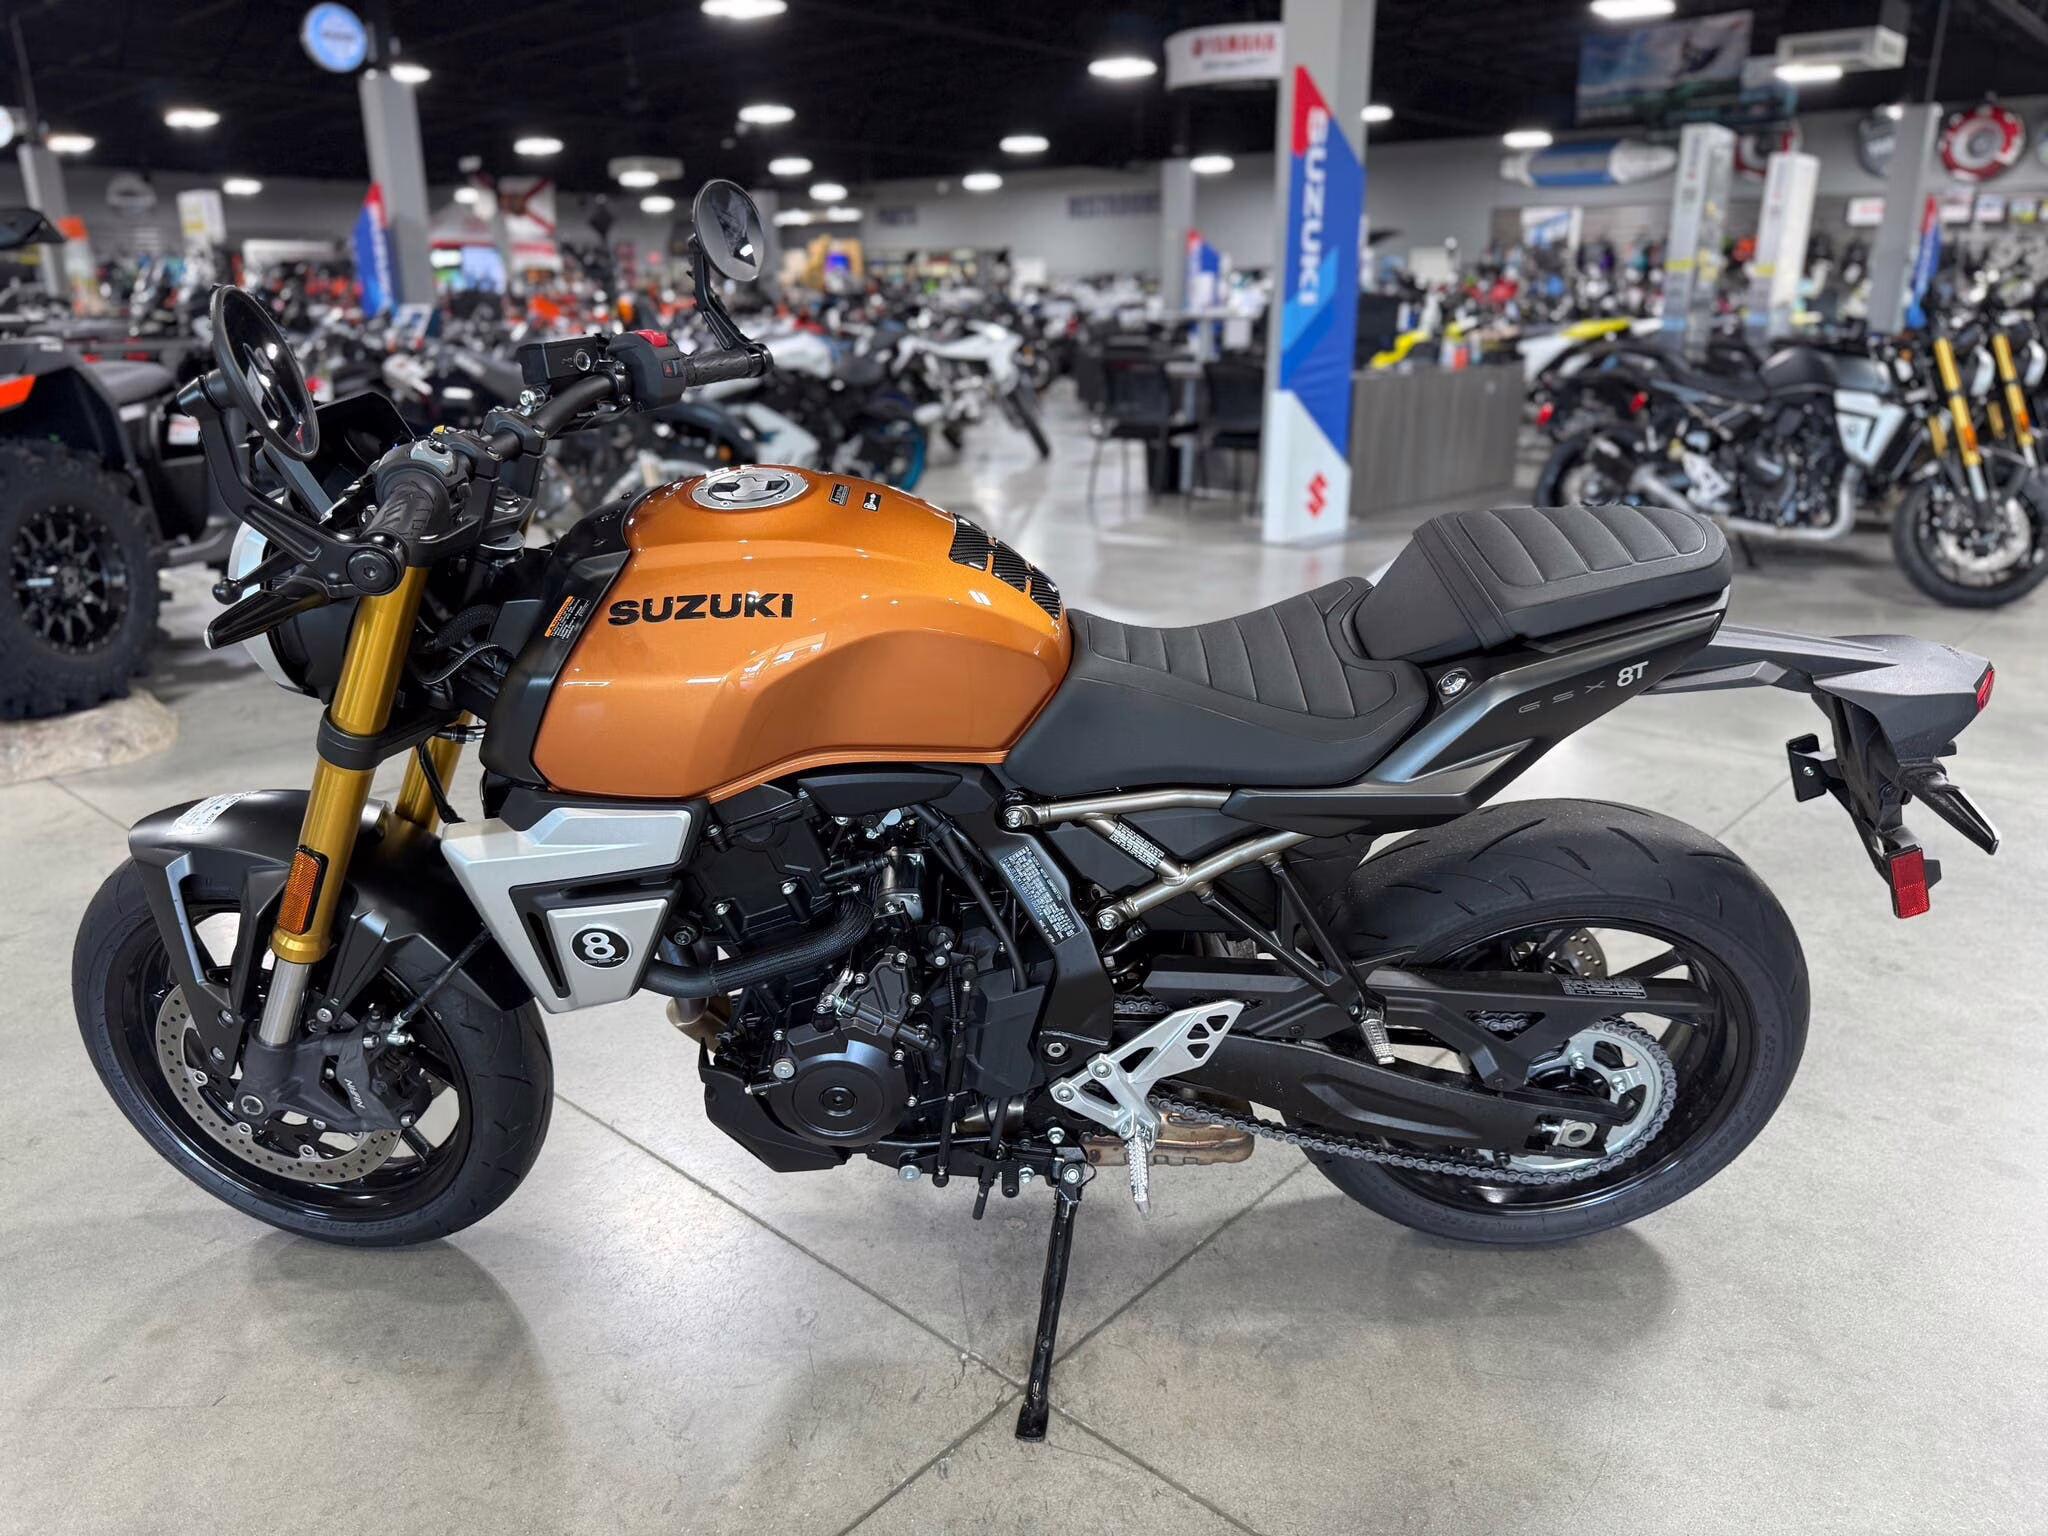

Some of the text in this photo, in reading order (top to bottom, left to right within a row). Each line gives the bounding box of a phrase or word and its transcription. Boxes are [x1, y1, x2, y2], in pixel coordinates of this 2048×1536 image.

[1298, 106, 1330, 306] SUZUKI
[607, 592, 794, 627] SUZUKI
[1616, 660, 1649, 688] 8T
[582, 932, 616, 960] 8
